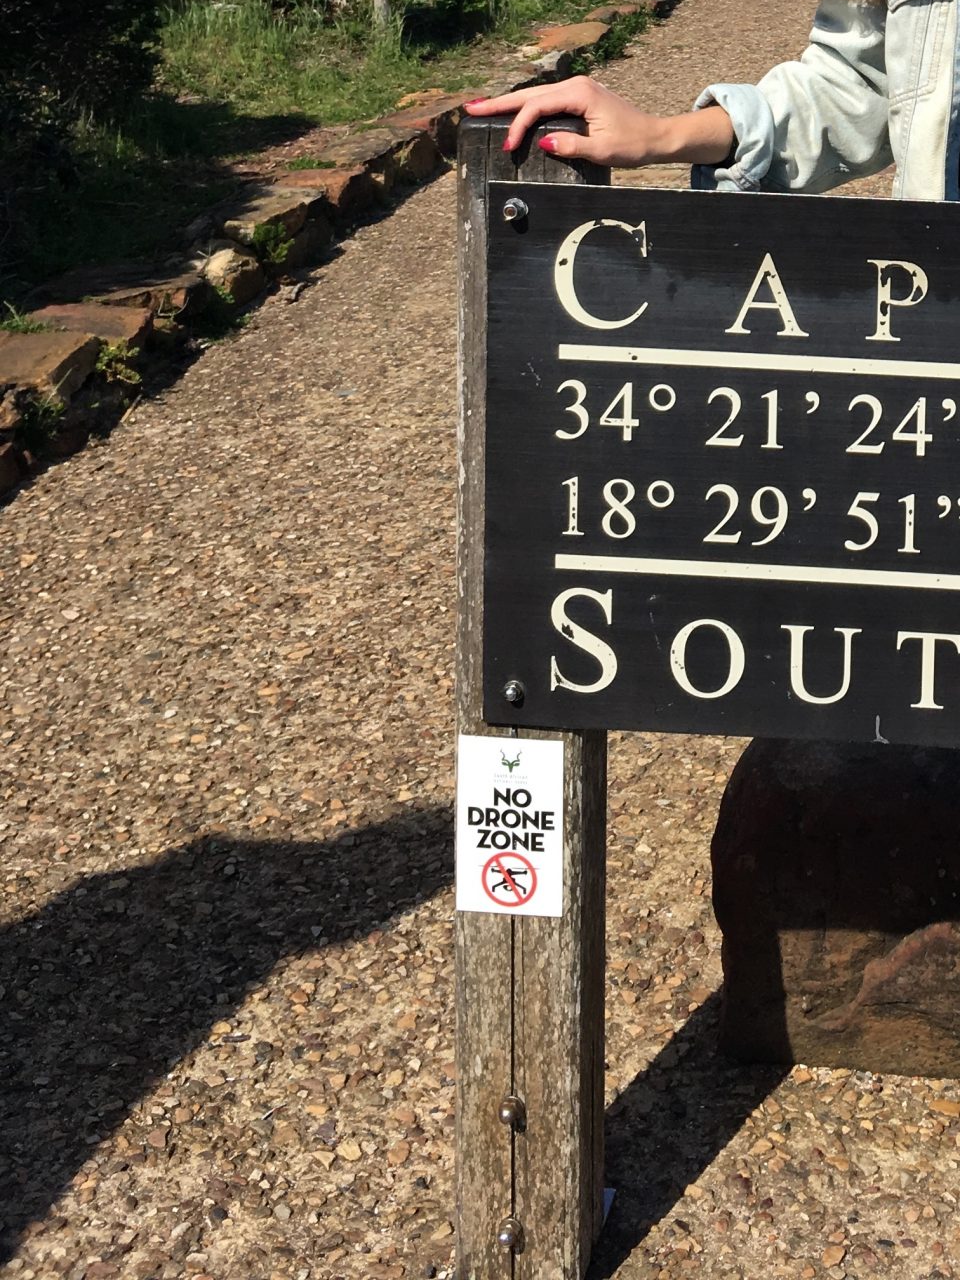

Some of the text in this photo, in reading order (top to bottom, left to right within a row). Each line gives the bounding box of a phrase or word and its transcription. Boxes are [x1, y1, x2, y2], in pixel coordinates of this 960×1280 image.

[556, 380, 675, 441] 34°
[562, 477, 674, 538] 18°
[494, 788, 532, 807] NO
[468, 807, 554, 830] DRONE
[476, 829, 544, 852] ZONE
